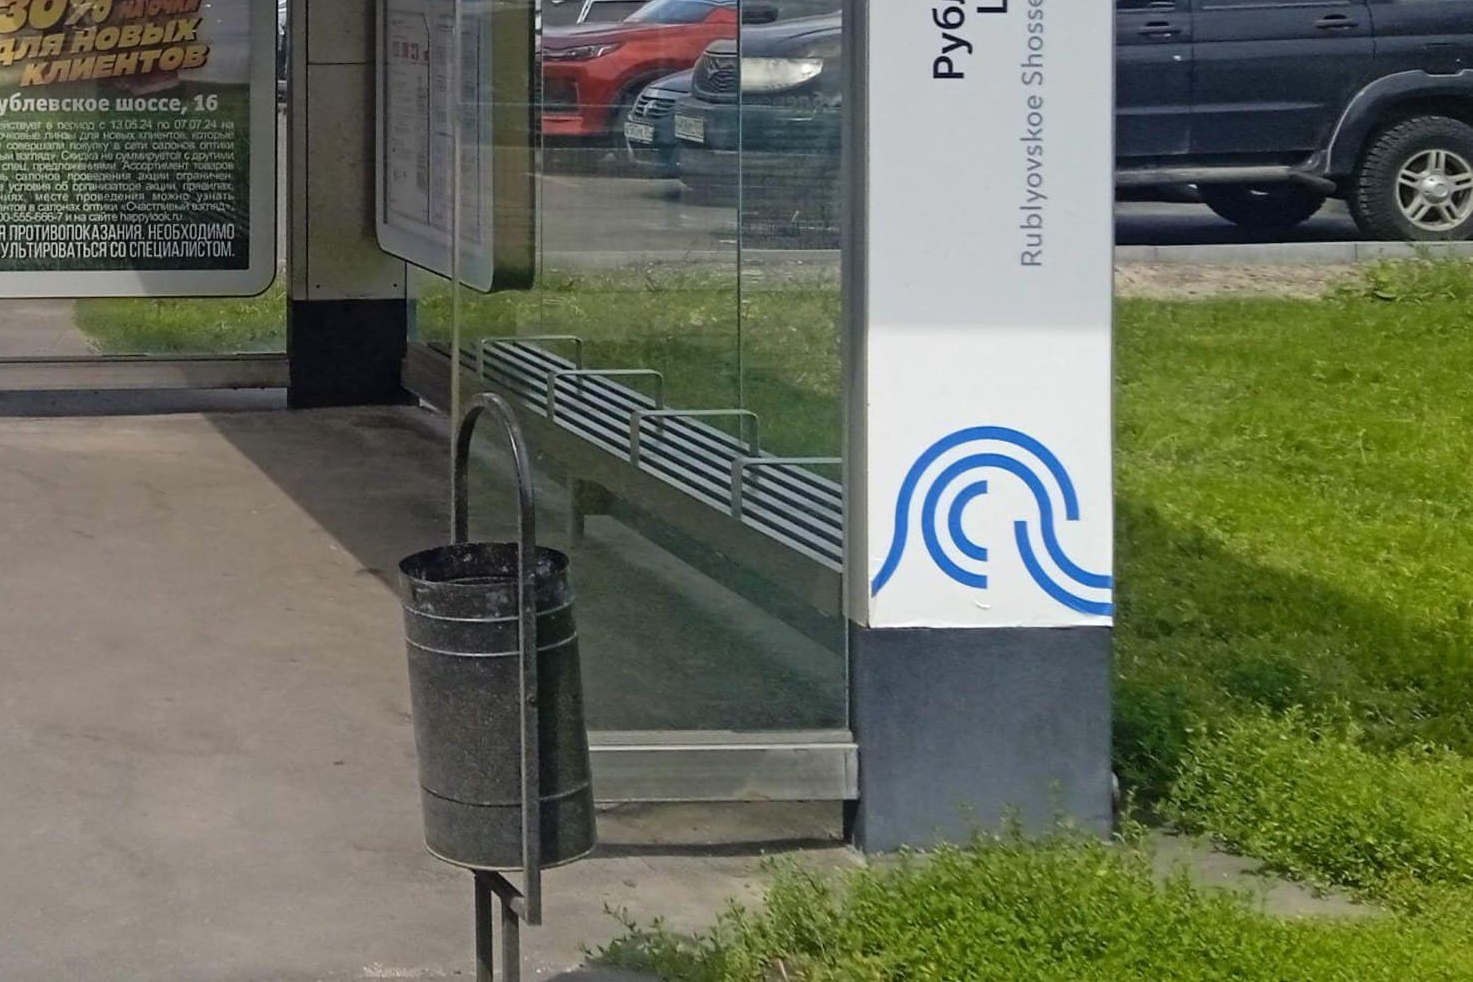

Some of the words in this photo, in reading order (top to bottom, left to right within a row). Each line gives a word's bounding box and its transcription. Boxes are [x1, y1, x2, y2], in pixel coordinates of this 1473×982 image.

[69, 18, 203, 54] НОВЫХ
[20, 44, 211, 87] КЛИЕНТОВ
[115, 96, 188, 115] шоссе,
[194, 94, 219, 112] 16
[157, 121, 170, 130] по
[55, 181, 69, 191] об
[1019, 93, 1050, 268] Rublyovskoe
[34, 192, 70, 202] месте
[9, 223, 145, 241] ПРОТИВОПОКАЗАНИЯ.
[148, 223, 235, 240] НЕОБХОДИМО
[110, 241, 127, 258] СО
[129, 241, 236, 258] СПЕЦИАЛИСТОМ.
